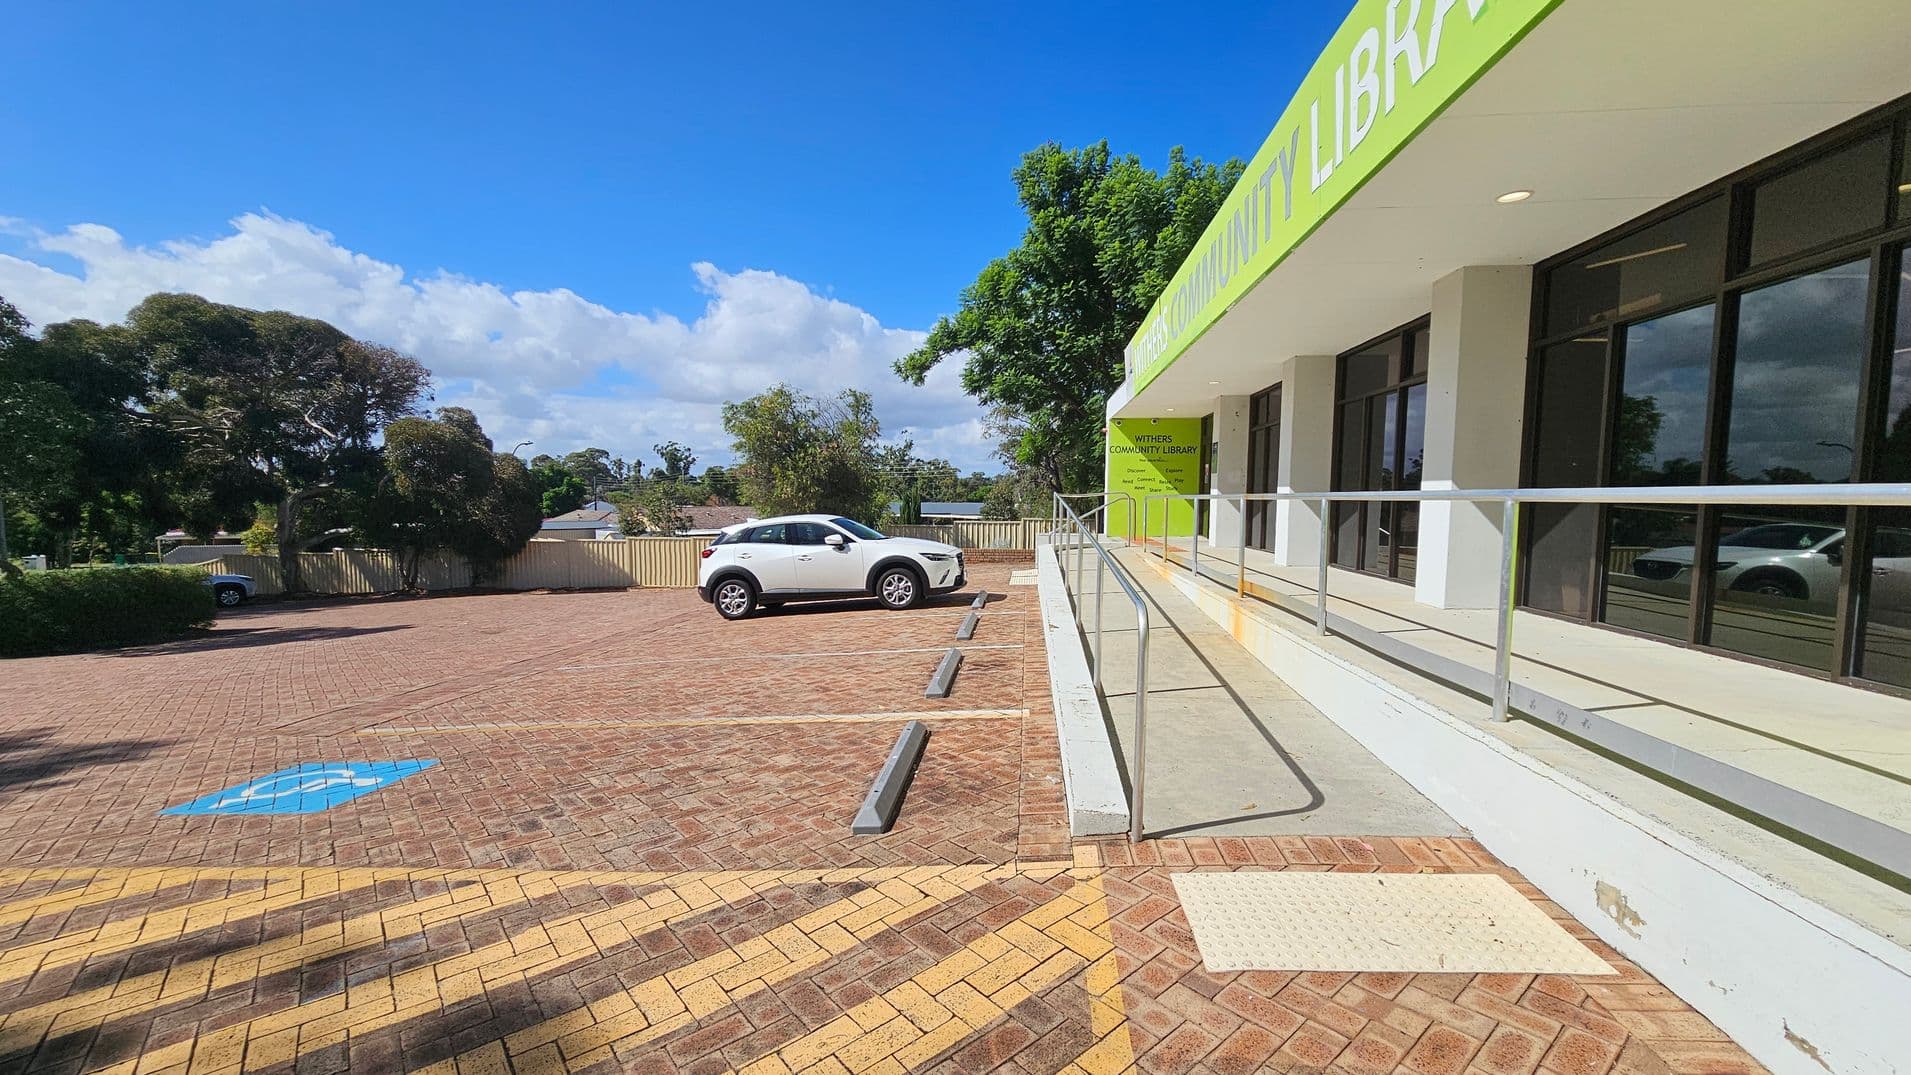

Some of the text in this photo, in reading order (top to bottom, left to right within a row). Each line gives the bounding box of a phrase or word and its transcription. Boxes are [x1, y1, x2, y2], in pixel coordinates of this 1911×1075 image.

[1134, 306, 1168, 378] WITHERS
[1170, 125, 1300, 340] COMMUNITY
[1135, 435, 1173, 443] WITHERS
[1109, 445, 1198, 454] COMMUNITY LIBRARY
